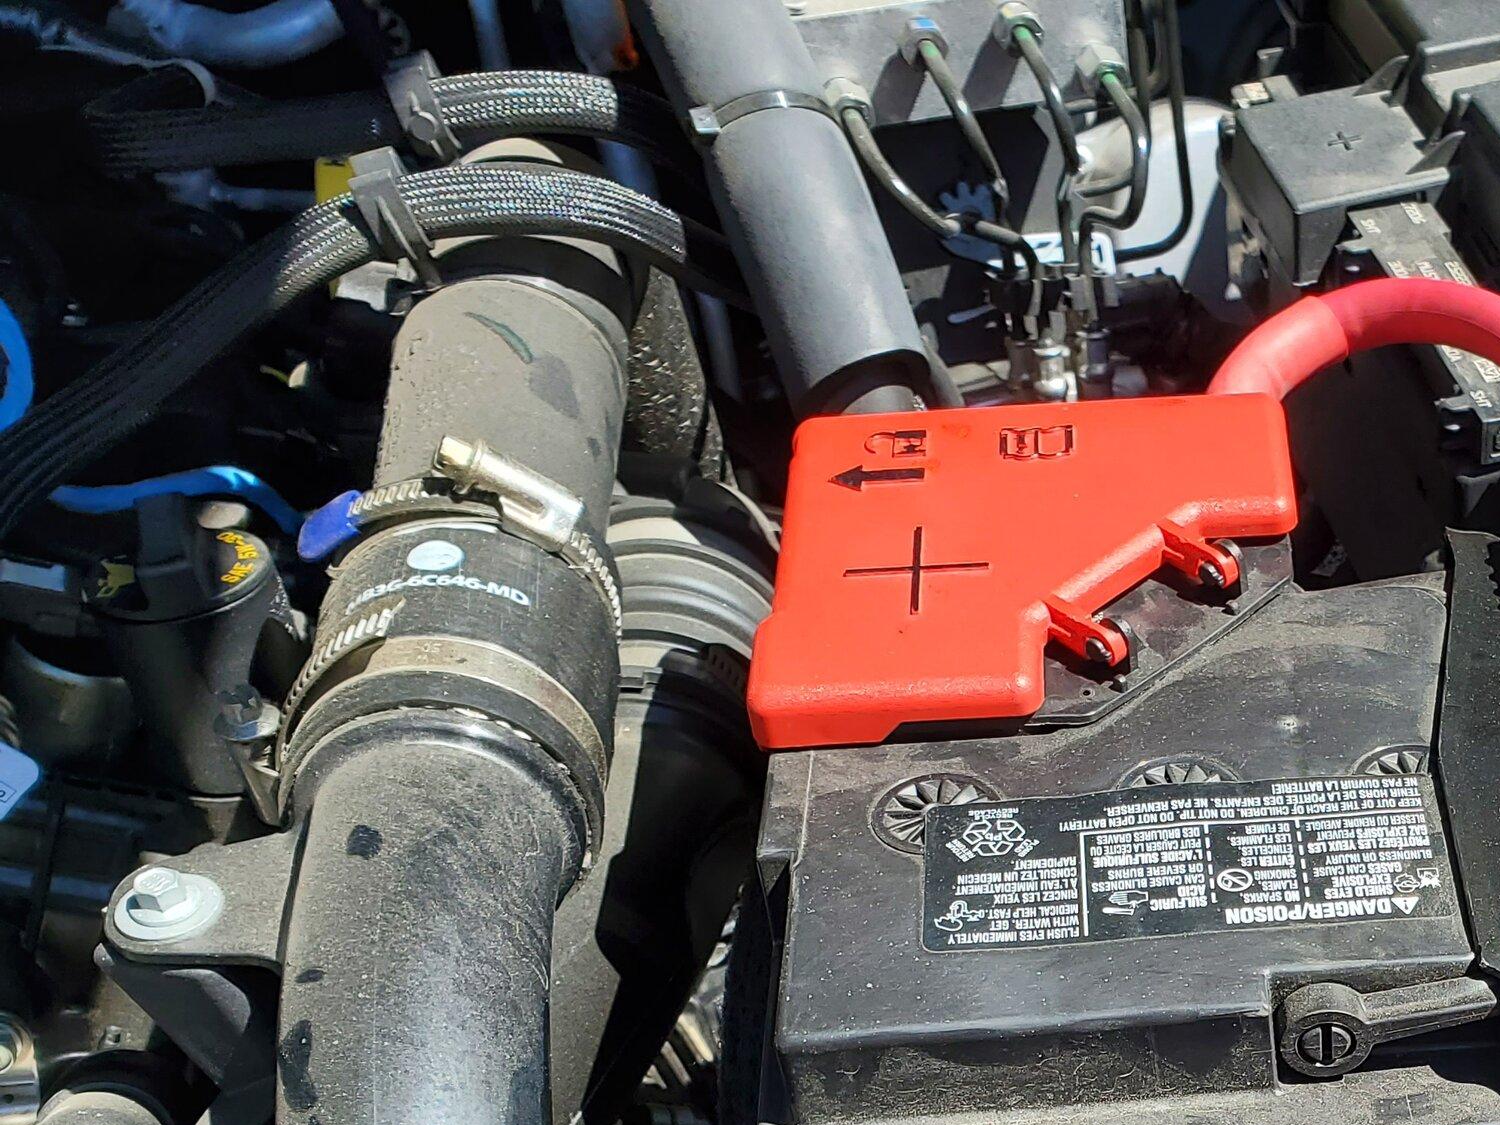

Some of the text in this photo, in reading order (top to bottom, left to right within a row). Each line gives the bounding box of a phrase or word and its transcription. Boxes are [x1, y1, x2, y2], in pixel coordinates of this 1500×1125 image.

[220, 562, 254, 584] SAE
[1324, 780, 1338, 791] LA
[1340, 779, 1380, 790] OUVRIR
[1382, 777, 1402, 788] PAS
[1404, 777, 1418, 787] NE
[1326, 791, 1340, 802] LA
[1342, 790, 1357, 800] DE
[1359, 789, 1388, 800] HORS
[1390, 788, 1421, 798] TENIR
[1170, 798, 1192, 810] PAS
[1193, 798, 1208, 808] NE
[1210, 796, 1260, 808] ENFANTS.
[1262, 796, 1284, 806] DES
[1059, 797, 1422, 832] KEEP OUT OF THE REACH OF CHILDREN. DO NOT TIP. DO NOT OPEN BATTERY!
[1244, 822, 1290, 834] DE FUMER
[1304, 814, 1425, 831] BLESSER OU RENDRE AVEUGLE
[984, 832, 1002, 841] Pb
[1182, 826, 1200, 838] DES
[1316, 824, 1428, 841] GAZ EXPLOSIFS PEUVENT
[1096, 834, 1132, 845] GRAVES
[1180, 838, 1202, 849] PEUT
[1274, 833, 1292, 844] LES
[1357, 838, 1376, 850] LES
[1090, 846, 1102, 856] OU
[1132, 842, 1144, 852] LA
[1146, 839, 1178, 852] CAUSER
[1307, 842, 1326, 853] LES
[1328, 840, 1356, 852] YEUX
[1010, 856, 1076, 870] RAPIDEMENT.
[1092, 848, 1203, 868] L'ACIDE SULFURIQUE
[1240, 856, 1258, 866] LES
[1325, 850, 1432, 864] BLINDNESS OR INJURY
[1020, 867, 1077, 882] CONSULTEZ
[1107, 862, 1204, 880] OR SEVERE BURNS
[1253, 868, 1297, 880] SMOKING
[1312, 862, 1402, 877] GASES CAN CAUSE
[1003, 872, 1018, 882] UN
[1092, 874, 1204, 892] CAN CAUSE BLINDNESS
[1331, 872, 1392, 888] EXPLOSIVE
[1040, 878, 1068, 891] L'EAU
[1177, 884, 1206, 897] ACID
[994, 889, 1078, 904] RINCEZ LES YEUX
[1284, 890, 1300, 902] NO
[1324, 884, 1394, 899] SHIELD EYES
[1149, 896, 1208, 911] SULFURIC
[986, 904, 1078, 919] MEDICAL HELP FAST.
[1225, 898, 1392, 924] DANGER/POISON
[990, 920, 1010, 930] GET
[1052, 915, 1079, 928] WITH
[948, 927, 1080, 944] FLUSH EYES IMMEDIATELY
